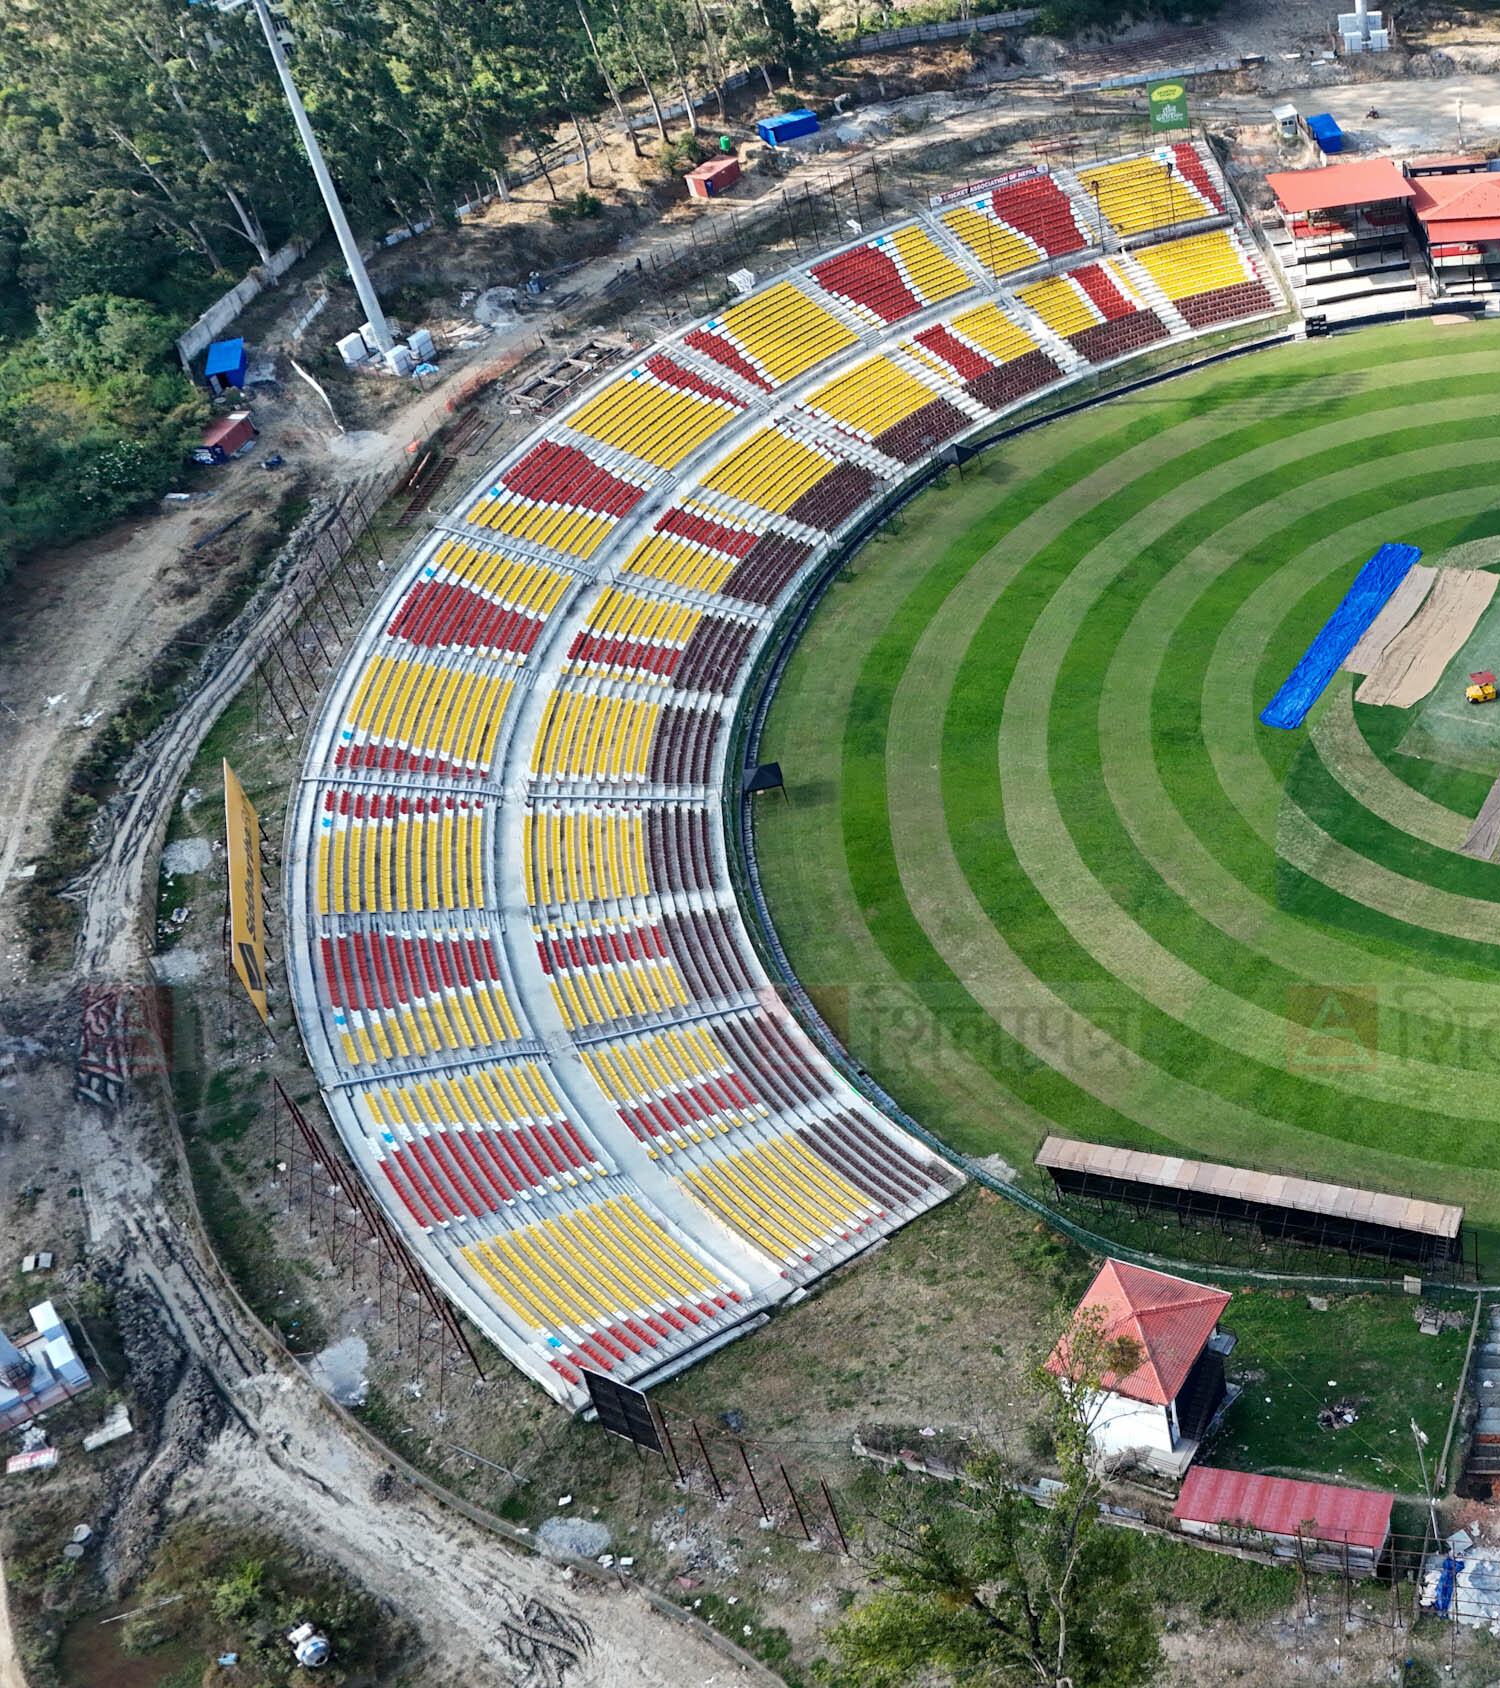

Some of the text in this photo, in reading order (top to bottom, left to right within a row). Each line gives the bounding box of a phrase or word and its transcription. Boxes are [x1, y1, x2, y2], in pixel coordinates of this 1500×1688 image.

[944, 168, 1037, 200] CRICKET ASSOCIATION OF NEPAL
